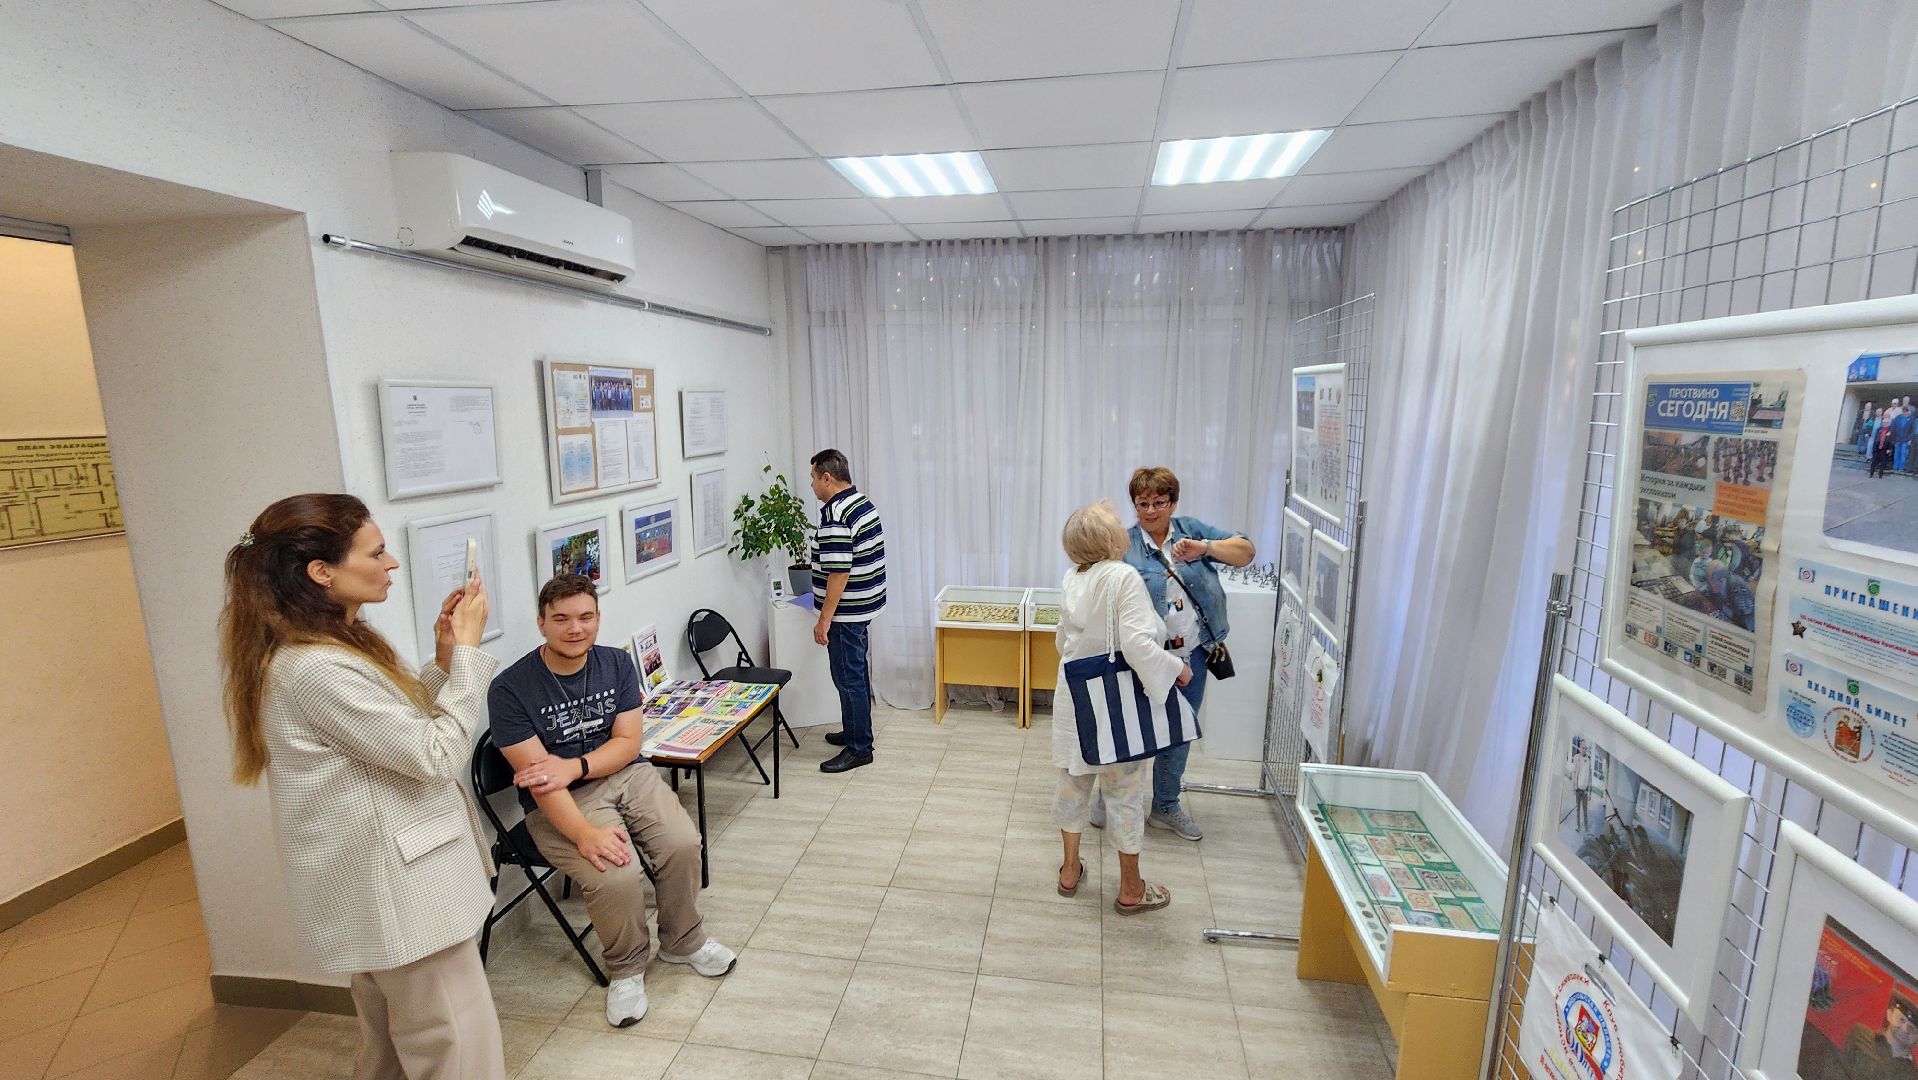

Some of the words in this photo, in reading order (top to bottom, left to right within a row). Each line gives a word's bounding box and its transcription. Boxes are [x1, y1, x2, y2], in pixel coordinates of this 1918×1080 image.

[1669, 387, 1719, 399] ПРОТВИНО
[1658, 400, 1729, 422] СЕГОДНЯ
[49, 442, 106, 450] ЭВАКУАЦИИ
[546, 697, 617, 731] JEANS
[1807, 679, 1860, 709] ВХОДНОЙ
[1866, 703, 1908, 728] БИЛЕТ
